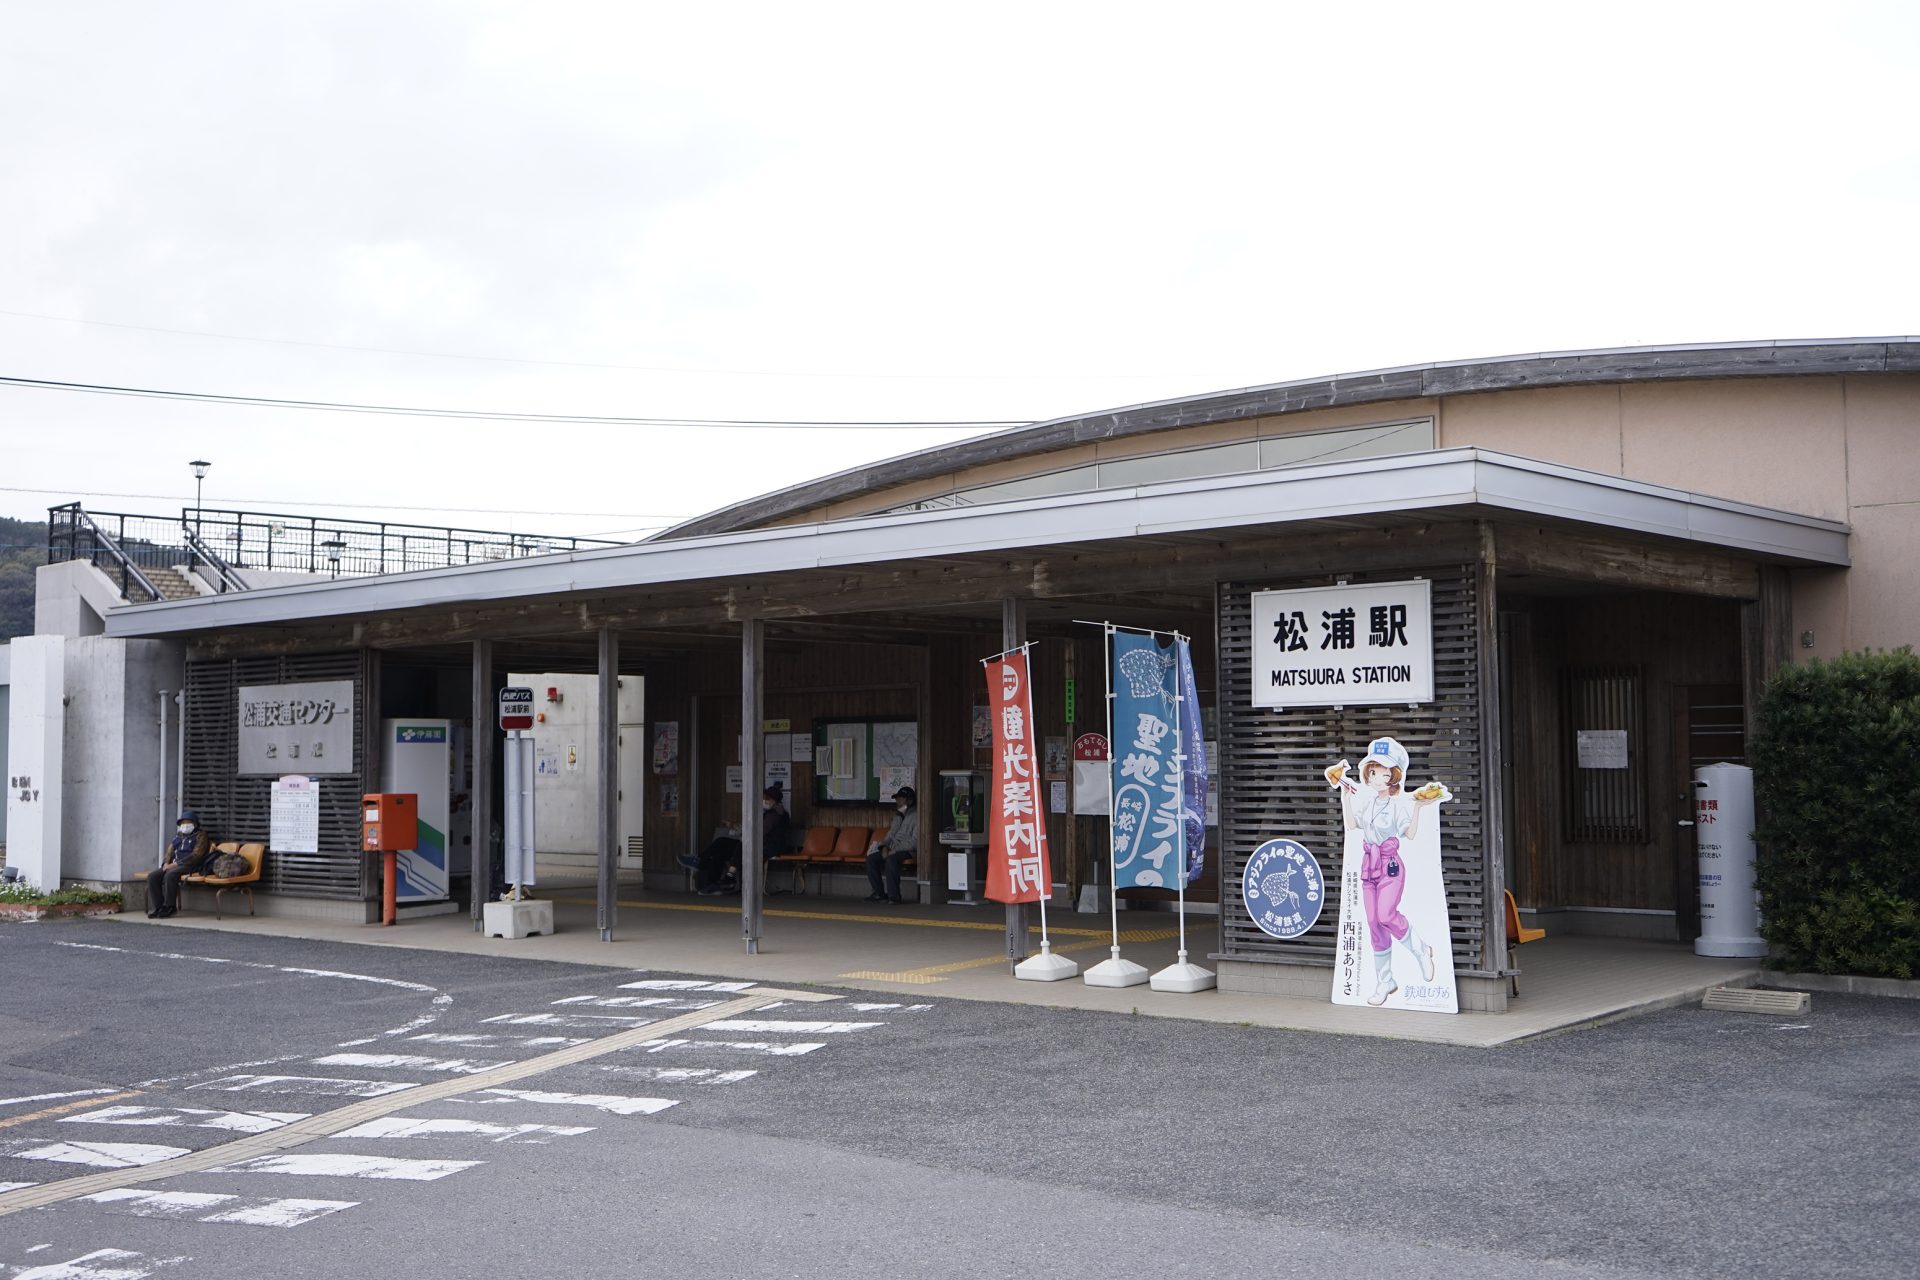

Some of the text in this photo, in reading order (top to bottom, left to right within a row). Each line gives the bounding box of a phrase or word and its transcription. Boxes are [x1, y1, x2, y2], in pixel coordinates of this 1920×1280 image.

[1273, 604, 1408, 652] 松浦駅
[1271, 665, 1410, 687] MATSUURA STATION
[244, 699, 350, 727] 松浦交通センター
[504, 704, 530, 714] 松浦駅前
[1077, 736, 1108, 750] おもてなし
[1120, 713, 1169, 786] 聖地
[1115, 811, 1137, 853] 松浦
[1303, 864, 1319, 891] 松浦
[1264, 910, 1303, 927] 松浦鉄道
[1343, 921, 1356, 996] 西浦ありさ
[1404, 985, 1450, 1001] 鉄道むすめ
